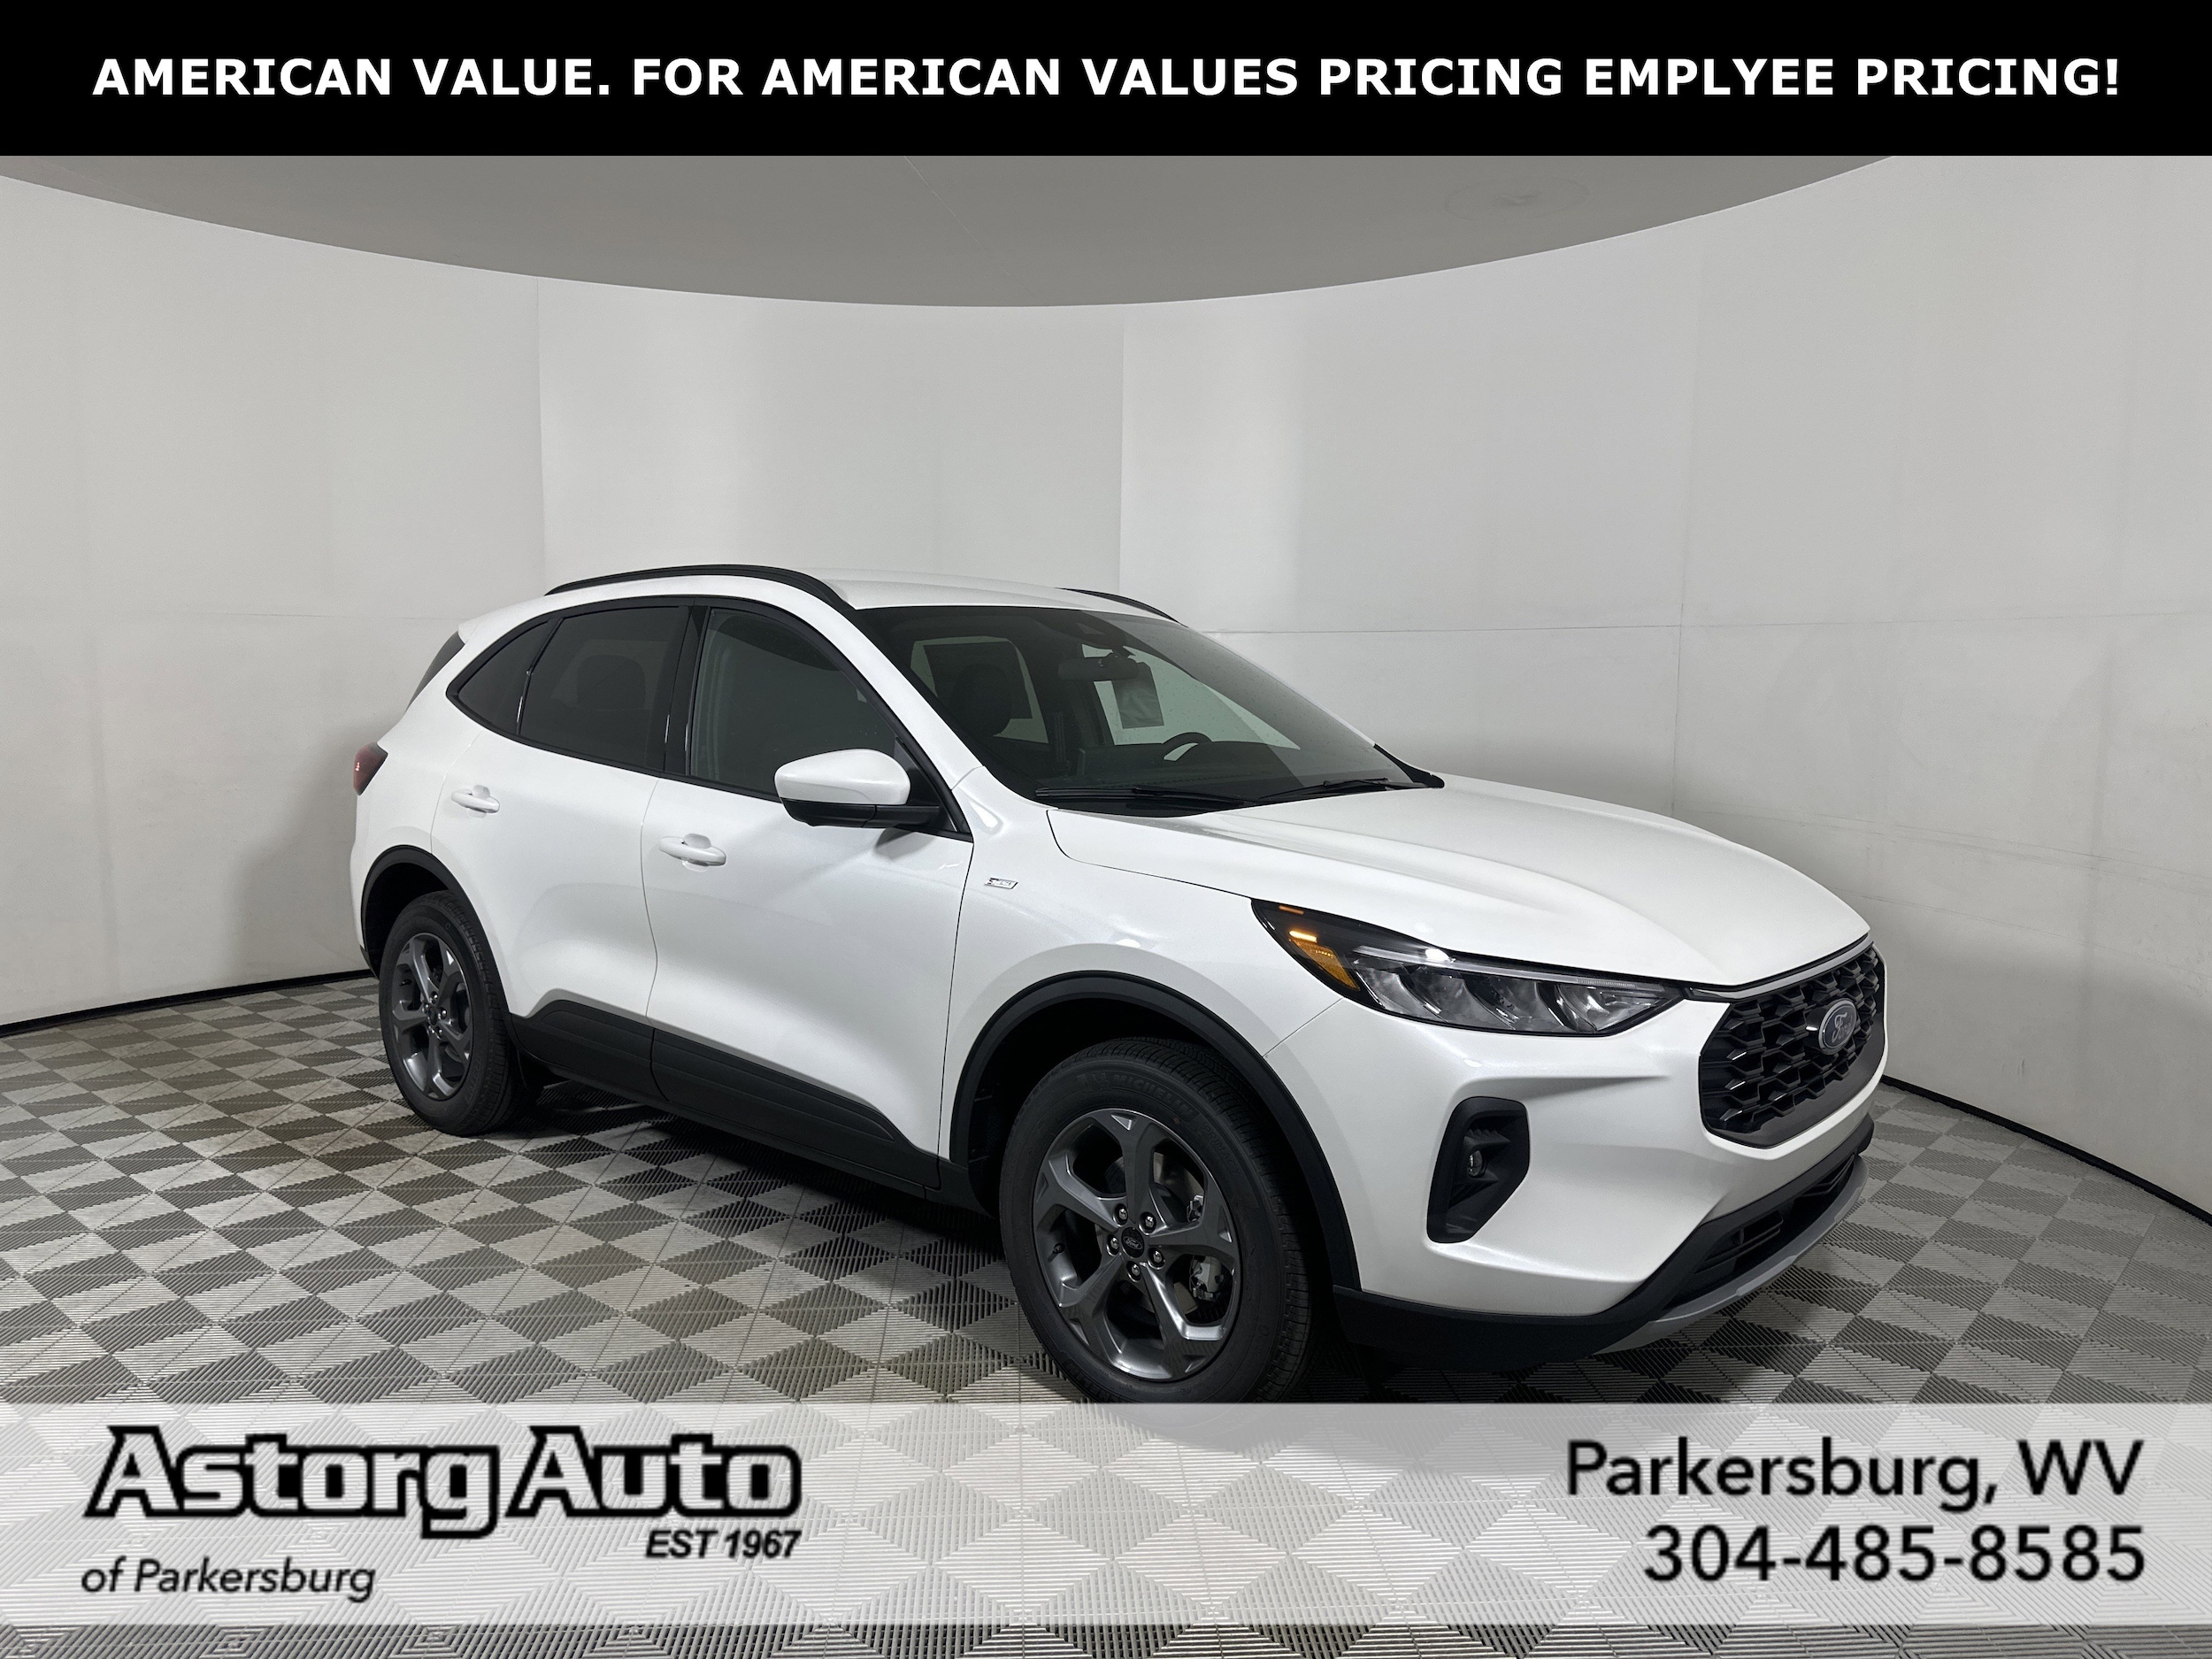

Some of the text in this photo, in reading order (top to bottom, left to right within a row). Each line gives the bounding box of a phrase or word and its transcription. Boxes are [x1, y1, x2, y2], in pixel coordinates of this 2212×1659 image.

[1831, 1011, 1854, 1043] Ford
[1111, 1073, 1195, 1119] MICHELIN
[1202, 1124, 1242, 1177] PRIMACY
